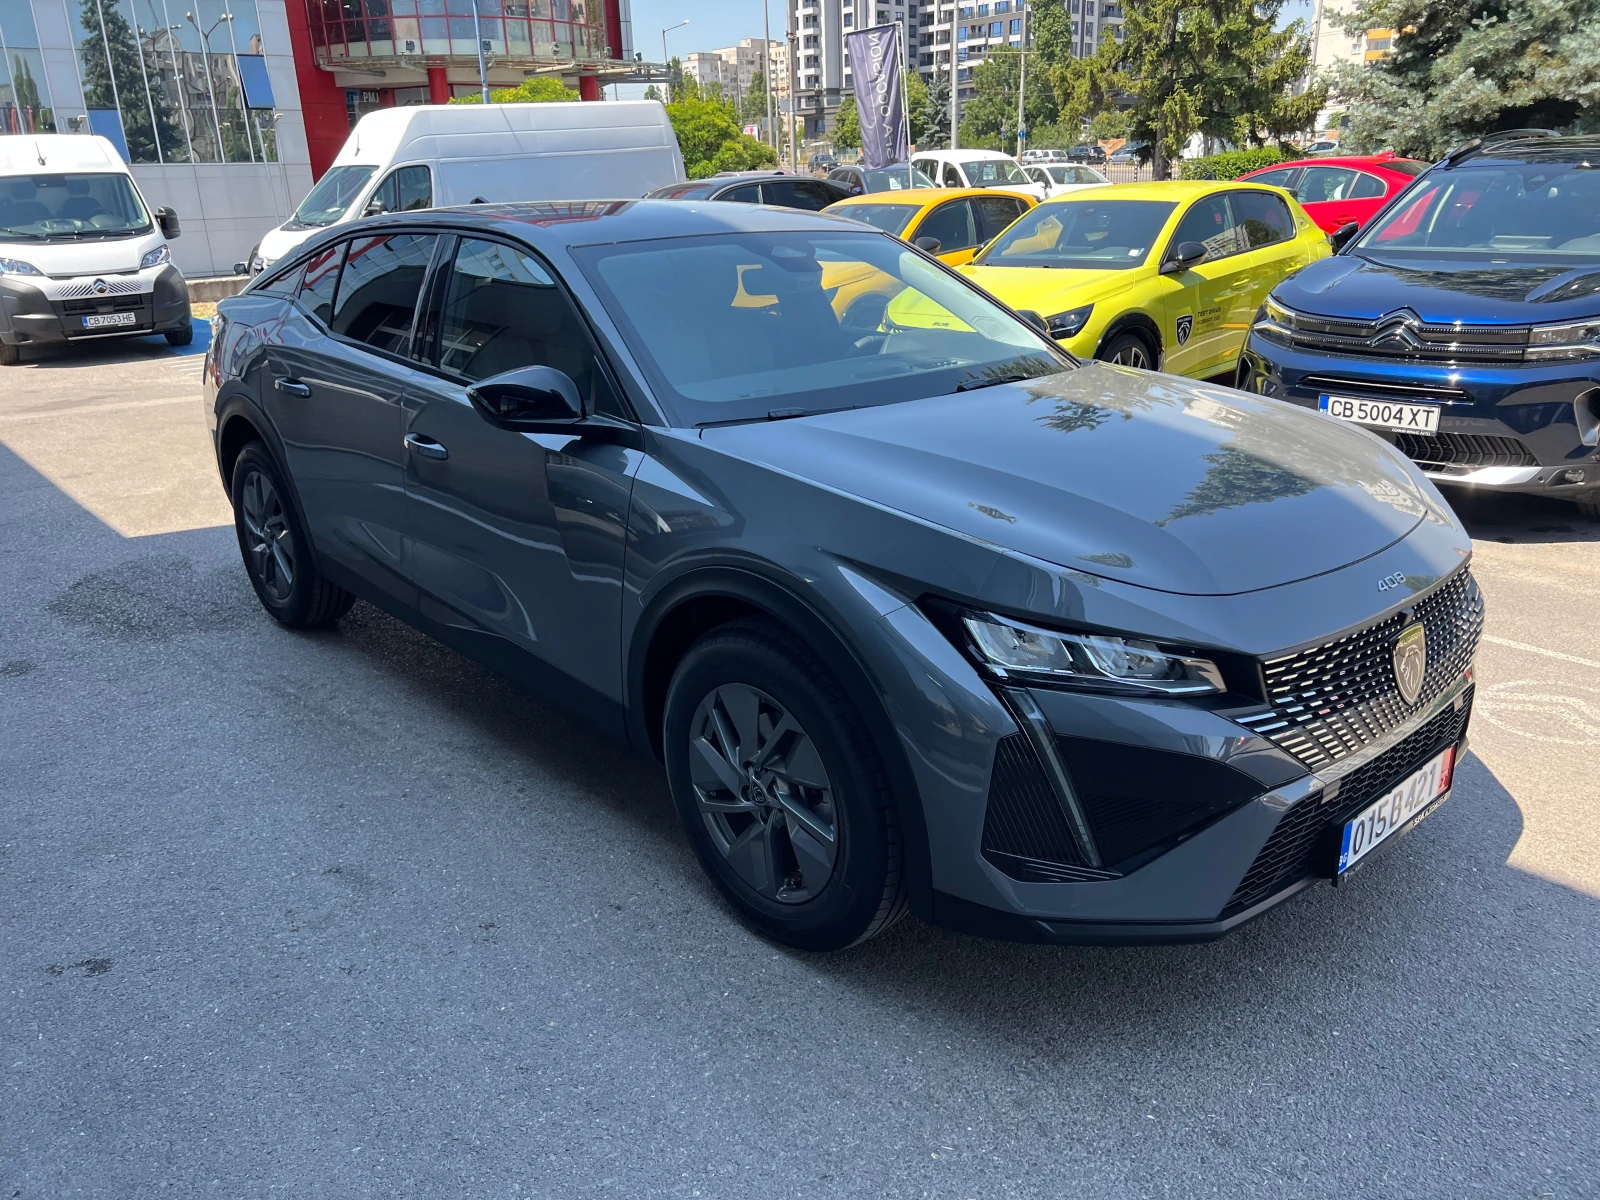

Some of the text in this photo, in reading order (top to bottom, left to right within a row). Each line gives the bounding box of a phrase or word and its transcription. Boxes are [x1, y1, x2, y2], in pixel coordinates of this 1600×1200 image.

[88, 313, 134, 326] CB 7053 HE
[1331, 400, 1434, 428] CB 5004 XT
[1378, 571, 1406, 592] 408
[1353, 762, 1438, 856] 015B421
